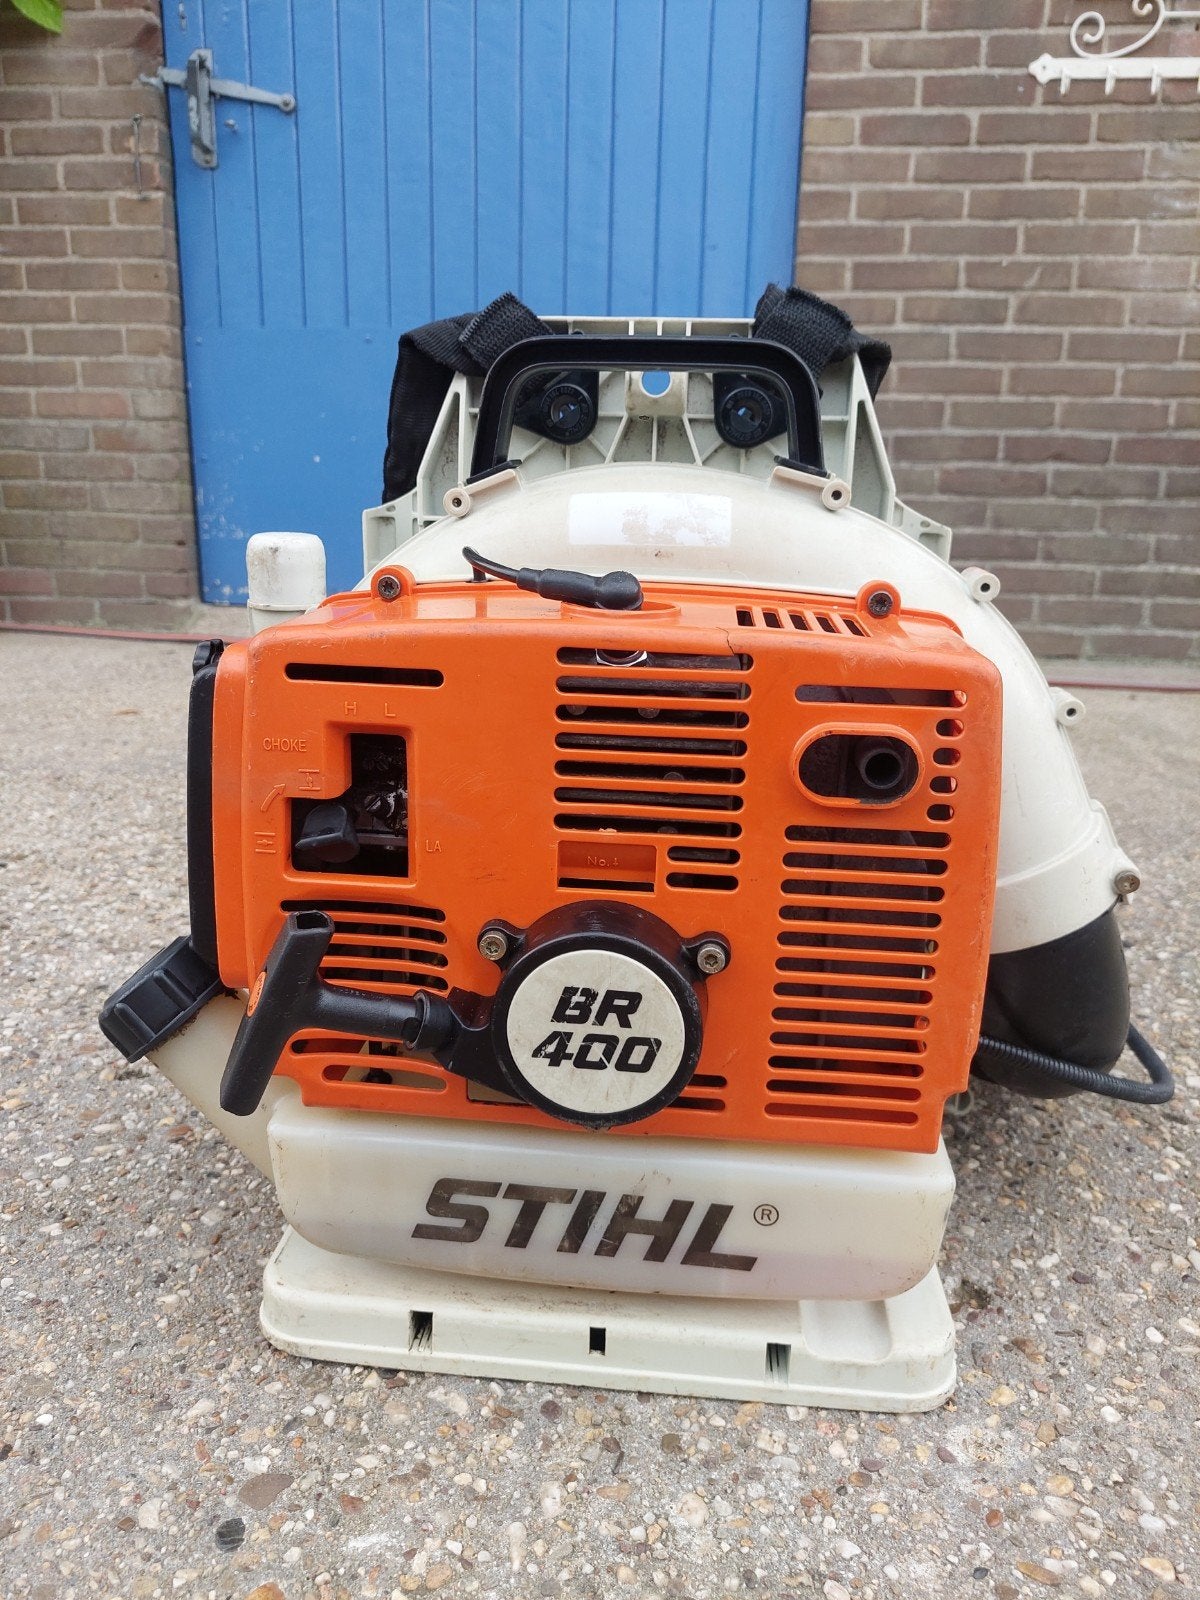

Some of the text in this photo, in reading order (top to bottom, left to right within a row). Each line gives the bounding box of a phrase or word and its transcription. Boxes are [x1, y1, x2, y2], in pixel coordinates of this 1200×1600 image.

[344, 701, 396, 717] H L
[262, 737, 307, 752] CHOKE
[425, 839, 442, 853] LA
[550, 986, 643, 1029] BR
[531, 1030, 662, 1073] 400
[411, 1177, 758, 1272] STIHL
